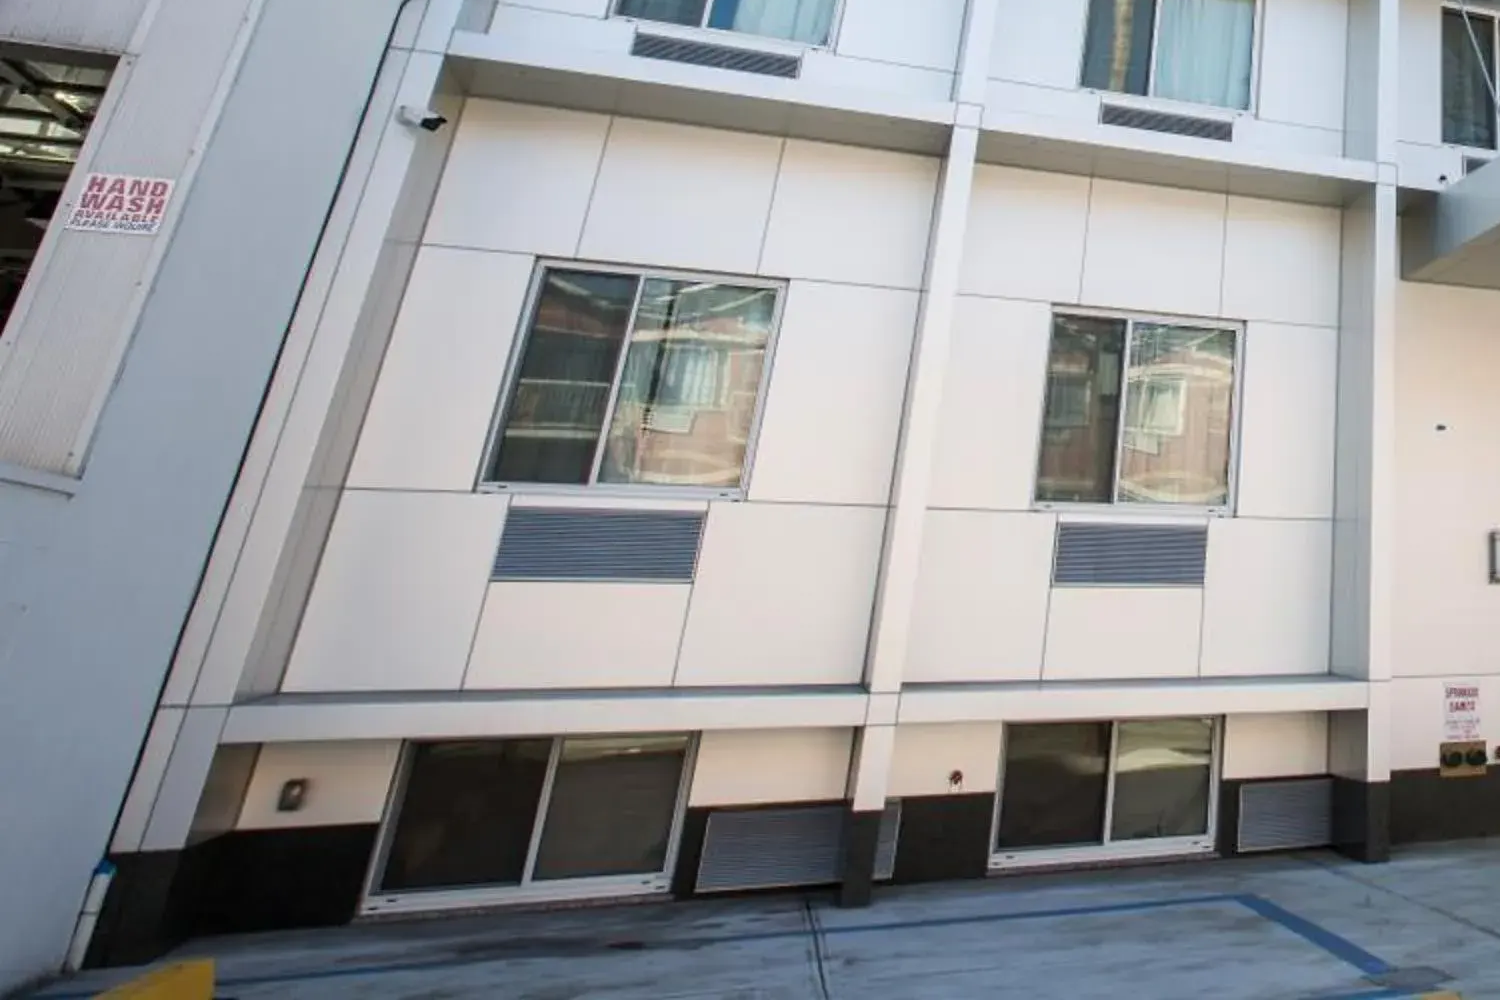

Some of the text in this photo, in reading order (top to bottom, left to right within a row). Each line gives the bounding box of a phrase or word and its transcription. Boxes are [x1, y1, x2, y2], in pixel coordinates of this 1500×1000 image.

[88, 175, 169, 197] HAND
[80, 192, 165, 215] WASH
[74, 209, 159, 223] AVAILABLE
